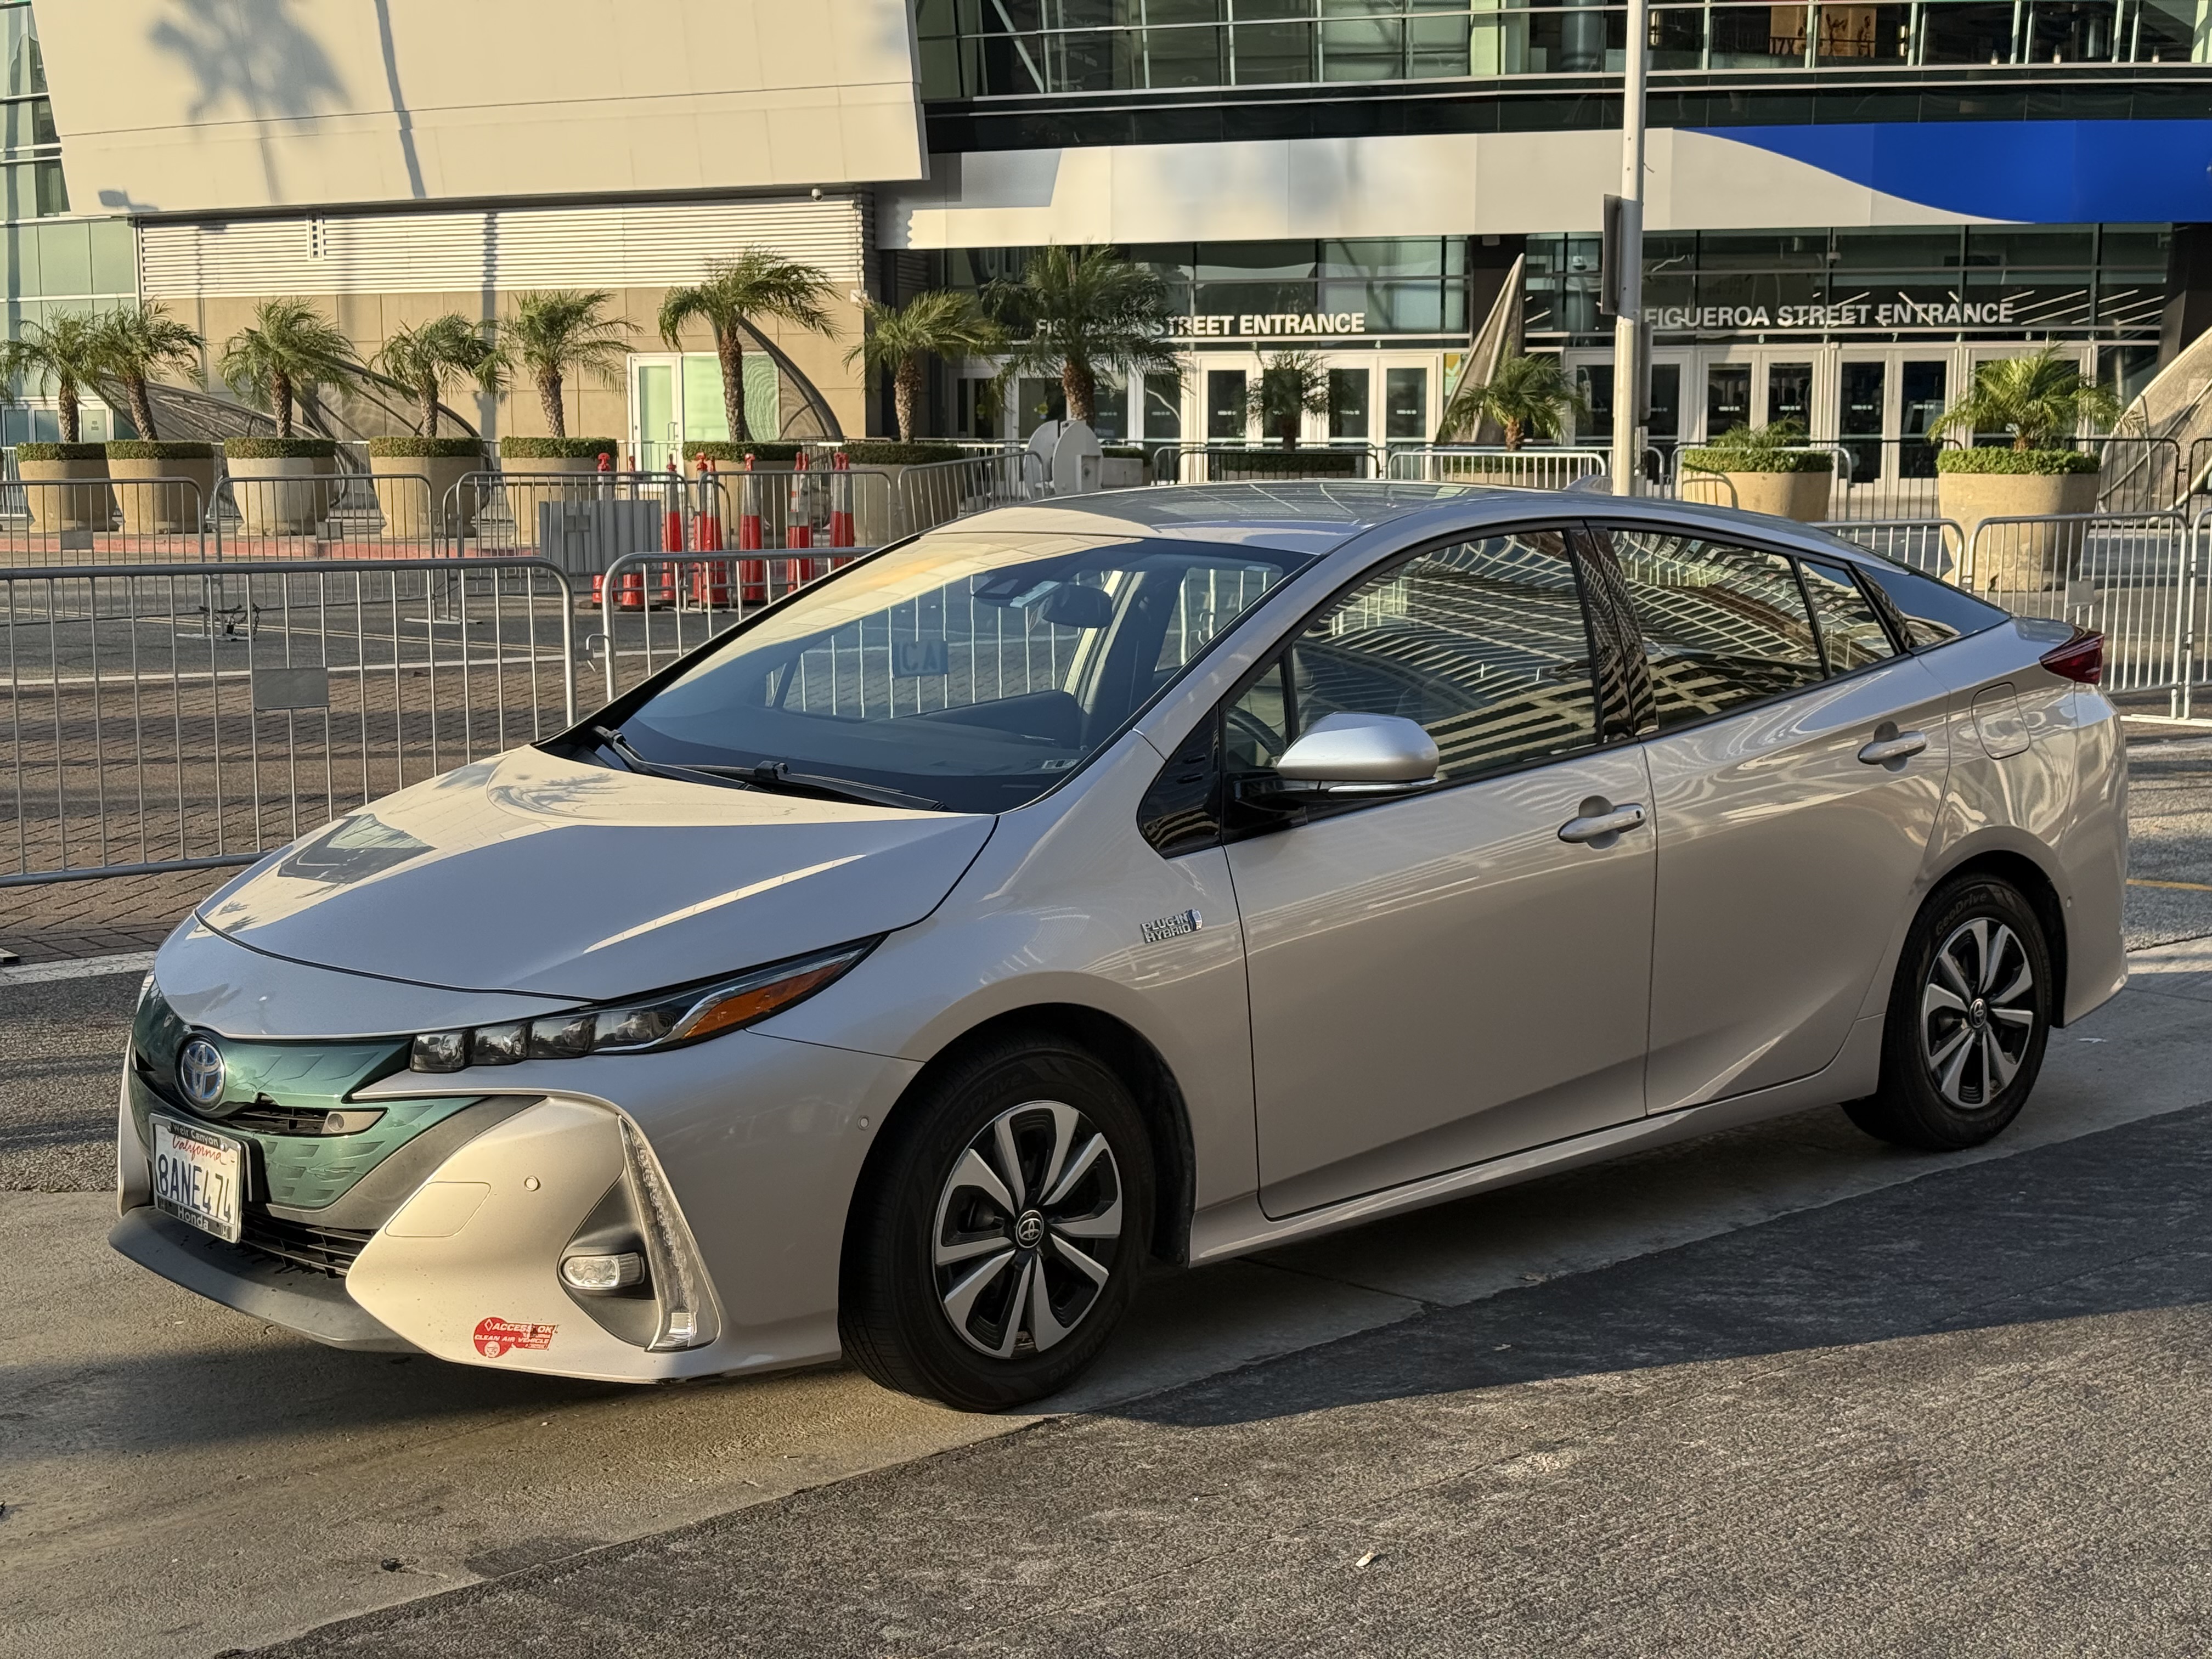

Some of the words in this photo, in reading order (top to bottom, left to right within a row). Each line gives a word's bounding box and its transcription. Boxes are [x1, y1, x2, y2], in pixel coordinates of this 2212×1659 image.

[1150, 314, 1234, 336] STREET
[1239, 312, 1365, 335] ENTRANCE
[1644, 305, 1770, 328] FIGUEROA
[1778, 304, 1872, 326] STREET
[1878, 302, 2014, 324] ENTRANCE
[1758, 334, 1765, 344] 6
[1892, 332, 1899, 343] 7
[2025, 331, 2032, 341] 8
[1144, 923, 1192, 943] HYBRID
[172, 1124, 189, 1137] Weir
[190, 1127, 219, 1147] Canyon
[172, 1135, 227, 1166] California
[158, 1154, 232, 1223] 8ANE474
[178, 1205, 209, 1231] Honda
[492, 1323, 531, 1333] ACCESS
[537, 1325, 553, 1334] OK
